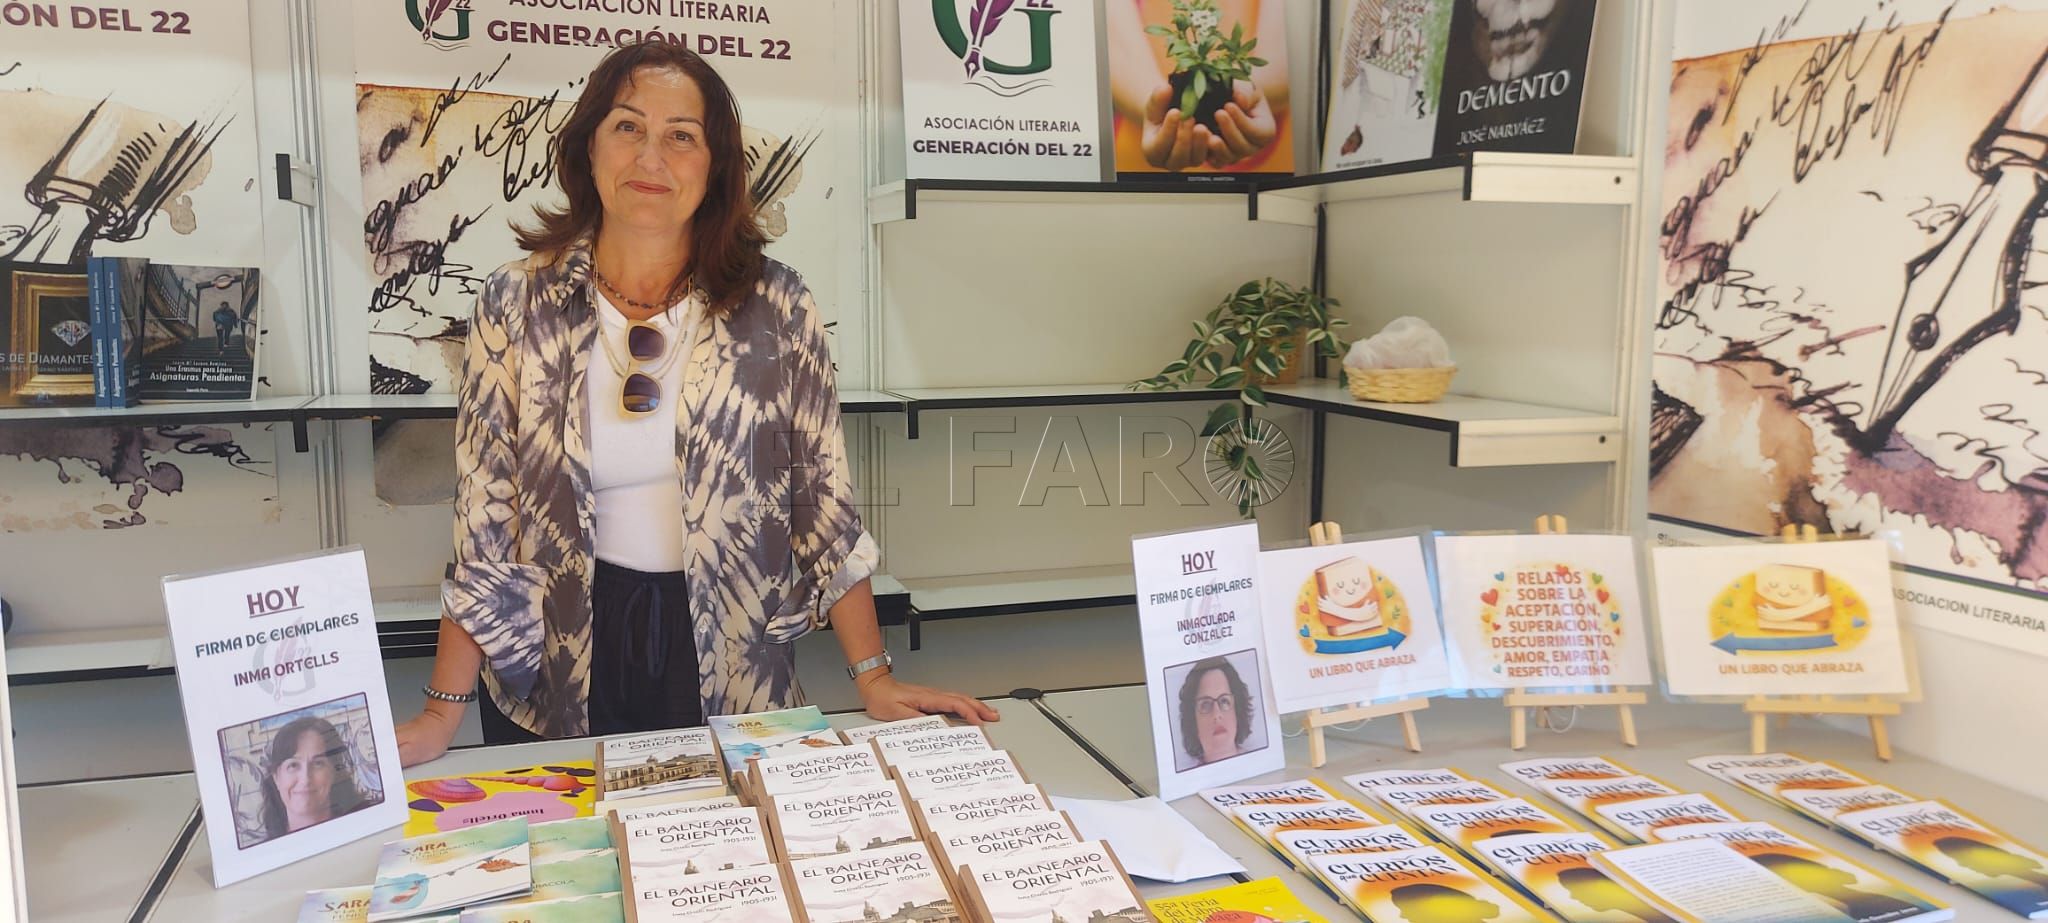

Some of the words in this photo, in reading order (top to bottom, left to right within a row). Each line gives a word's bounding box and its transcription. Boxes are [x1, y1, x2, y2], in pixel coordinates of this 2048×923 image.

[71, 6, 142, 32] DEL
[151, 10, 192, 34] 22
[670, 0, 770, 24] LITERARIA
[487, 20, 687, 49] GENERACIÓN
[698, 34, 752, 57] DEL
[760, 38, 791, 60] 22
[1457, 69, 1571, 115] DEMENTO
[924, 116, 1014, 132] ASOCIACIÓN
[1019, 120, 1081, 132] LITERARIA
[1456, 125, 1488, 145] JOSÉ
[1488, 117, 1546, 140] NARVÁEZ
[913, 138, 1030, 156] GENERACIÓN
[1035, 143, 1068, 157] DEL
[1073, 144, 1093, 157] 22
[29, 351, 94, 364] DIAMANTES
[150, 372, 199, 382] Asignaturas
[202, 372, 246, 382] Pendientes
[1181, 550, 1216, 573] HOY
[1517, 571, 1582, 585] RELATOS
[246, 585, 301, 616] HOY
[1150, 590, 1179, 605] FIRMA
[1180, 588, 1194, 600] DE
[1517, 588, 1564, 600] SOBRE
[1568, 588, 1586, 600] LA
[1177, 611, 1236, 632] INMACULADA
[1973, 606, 2046, 632] LITERARIA
[195, 636, 243, 658] FIRMA
[246, 631, 267, 648] DE
[1491, 634, 1615, 649] DESCUBRIMIENTO,
[233, 667, 271, 687] INMA
[274, 651, 340, 677] ORTELLS
[1309, 666, 1324, 679] UN
[1326, 663, 1353, 676] LIBRO
[1355, 660, 1375, 672] QUE
[1378, 654, 1417, 668] ABRAZA
[1719, 664, 1738, 674] UN
[1741, 664, 1778, 674] LIBRO
[1782, 663, 1808, 676] QUE
[1812, 662, 1864, 673] ABRAZA
[903, 732, 978, 746] BALNEARIO
[907, 740, 983, 753] ORIENTAL
[786, 752, 869, 771] BALNEARIO
[790, 760, 873, 778] ORIENTAL
[926, 758, 1006, 776] BALNEARIO
[931, 766, 1012, 784] ORIENTAL
[784, 804, 801, 812] EL
[804, 790, 894, 809] BALNEARIO
[930, 806, 947, 814] EL
[949, 793, 1036, 811] BALNEARIO
[1213, 786, 1317, 802] CUERPOS
[646, 802, 734, 819] BALNEARIO
[808, 799, 897, 819] ORIENTAL
[955, 802, 1041, 821] ORIENTAL
[1249, 806, 1356, 821] CUERPOS
[1430, 804, 1537, 822] CUERPOS
[634, 829, 652, 838] EL
[657, 817, 752, 835] BALNEARIO
[660, 826, 754, 843] ORIENTAL
[950, 839, 968, 847] EL
[971, 822, 1062, 844] BALNEARIO
[398, 841, 448, 857] SARA
[978, 831, 1068, 854] ORIENTAL
[1294, 832, 1408, 849] CUERPOS
[1492, 840, 1606, 859] CUERPOS
[803, 870, 821, 878] EL
[825, 852, 922, 874] BALNEARIO
[831, 862, 927, 884] ORIENTAL
[982, 873, 1002, 882] EL
[1005, 853, 1102, 879] BALNEARIO
[1328, 854, 1447, 875] CUERPOS
[1012, 863, 1109, 890] ORIENTAL
[644, 891, 663, 900] EL
[668, 875, 772, 897] BALNEARIO
[671, 885, 776, 907] ORIENTAL
